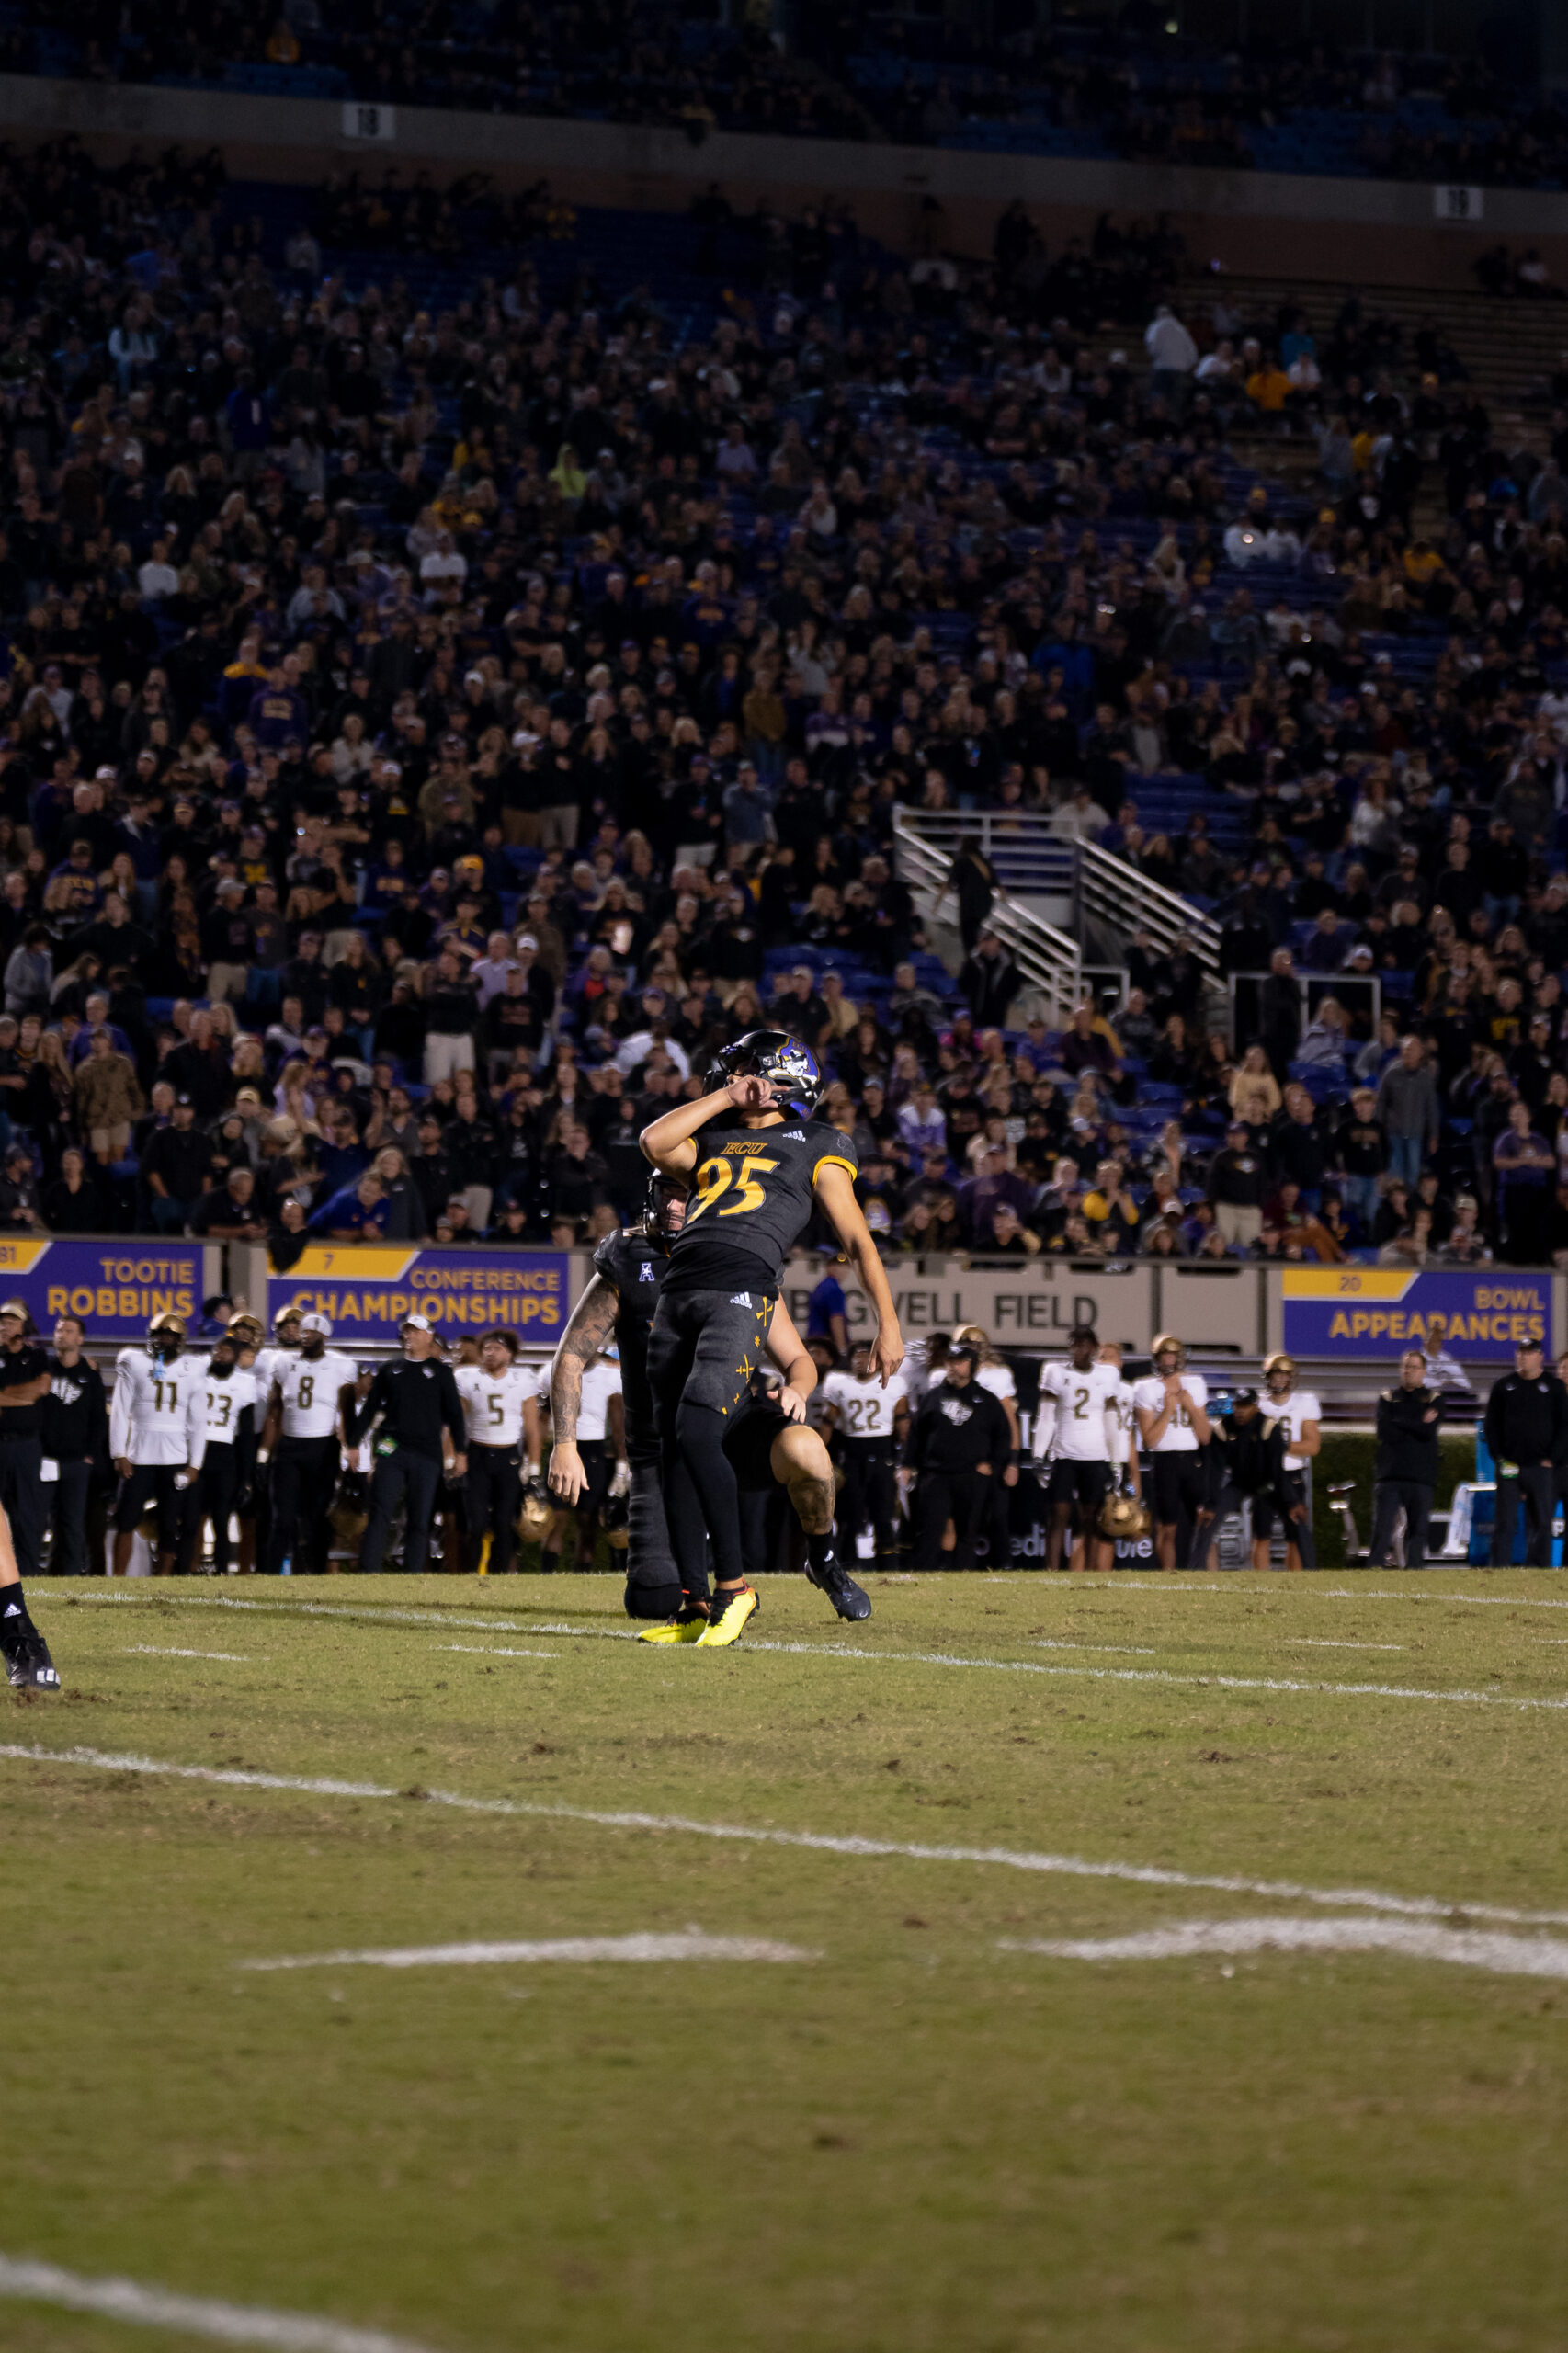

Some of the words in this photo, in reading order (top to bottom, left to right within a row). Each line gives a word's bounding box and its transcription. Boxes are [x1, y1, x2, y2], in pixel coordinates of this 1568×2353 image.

[720, 1142, 768, 1155] ECU
[686, 1155, 781, 1225] 95
[100, 1257, 196, 1284] TOOTIE
[324, 1253, 335, 1270] 7
[410, 1267, 560, 1292] CONFERENCE
[1339, 1275, 1362, 1292] 20
[46, 1285, 195, 1318] ROBBINS
[292, 1289, 560, 1325] CHAMPIONSHIPS
[790, 1290, 963, 1325] BGELL
[994, 1294, 1097, 1330] FIELD
[1474, 1284, 1545, 1310] BOWL
[153, 1380, 177, 1414] 11
[297, 1376, 315, 1411] 8
[1074, 1388, 1090, 1420] 2
[487, 1394, 504, 1426] 5
[847, 1399, 881, 1431] 22
